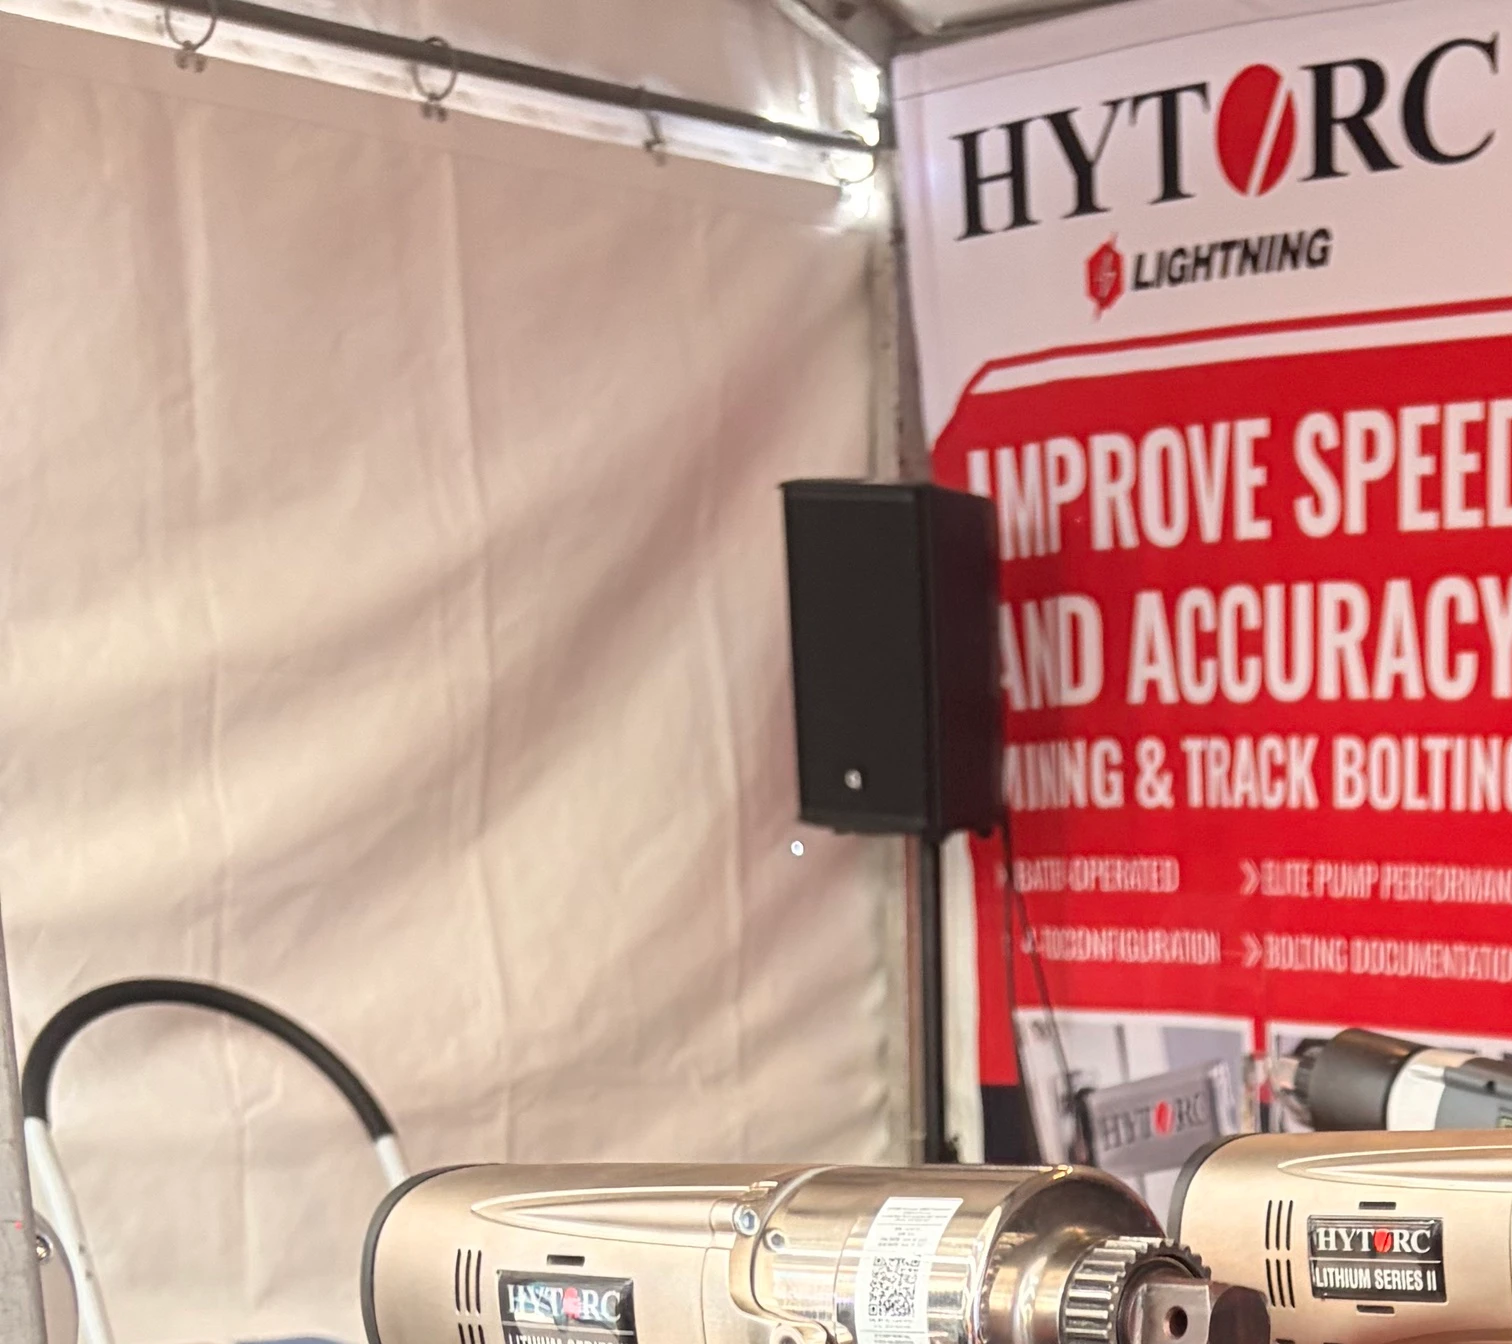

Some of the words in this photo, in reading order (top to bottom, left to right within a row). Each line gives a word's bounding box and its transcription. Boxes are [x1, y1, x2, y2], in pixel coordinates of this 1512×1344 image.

[951, 32, 1500, 241] HYTORC
[1131, 228, 1332, 290] LIGHTNING
[1136, 737, 1175, 809] &
[1180, 734, 1320, 811] TRACK
[1313, 860, 1379, 900] PUMP
[1263, 932, 1348, 974] BOLTING
[1316, 1227, 1431, 1254] HYTORC
[1315, 1267, 1371, 1290] LITHIUM
[1374, 1268, 1423, 1291] SERIES
[1426, 1270, 1437, 1291] II
[507, 1284, 621, 1322] HYTORC
